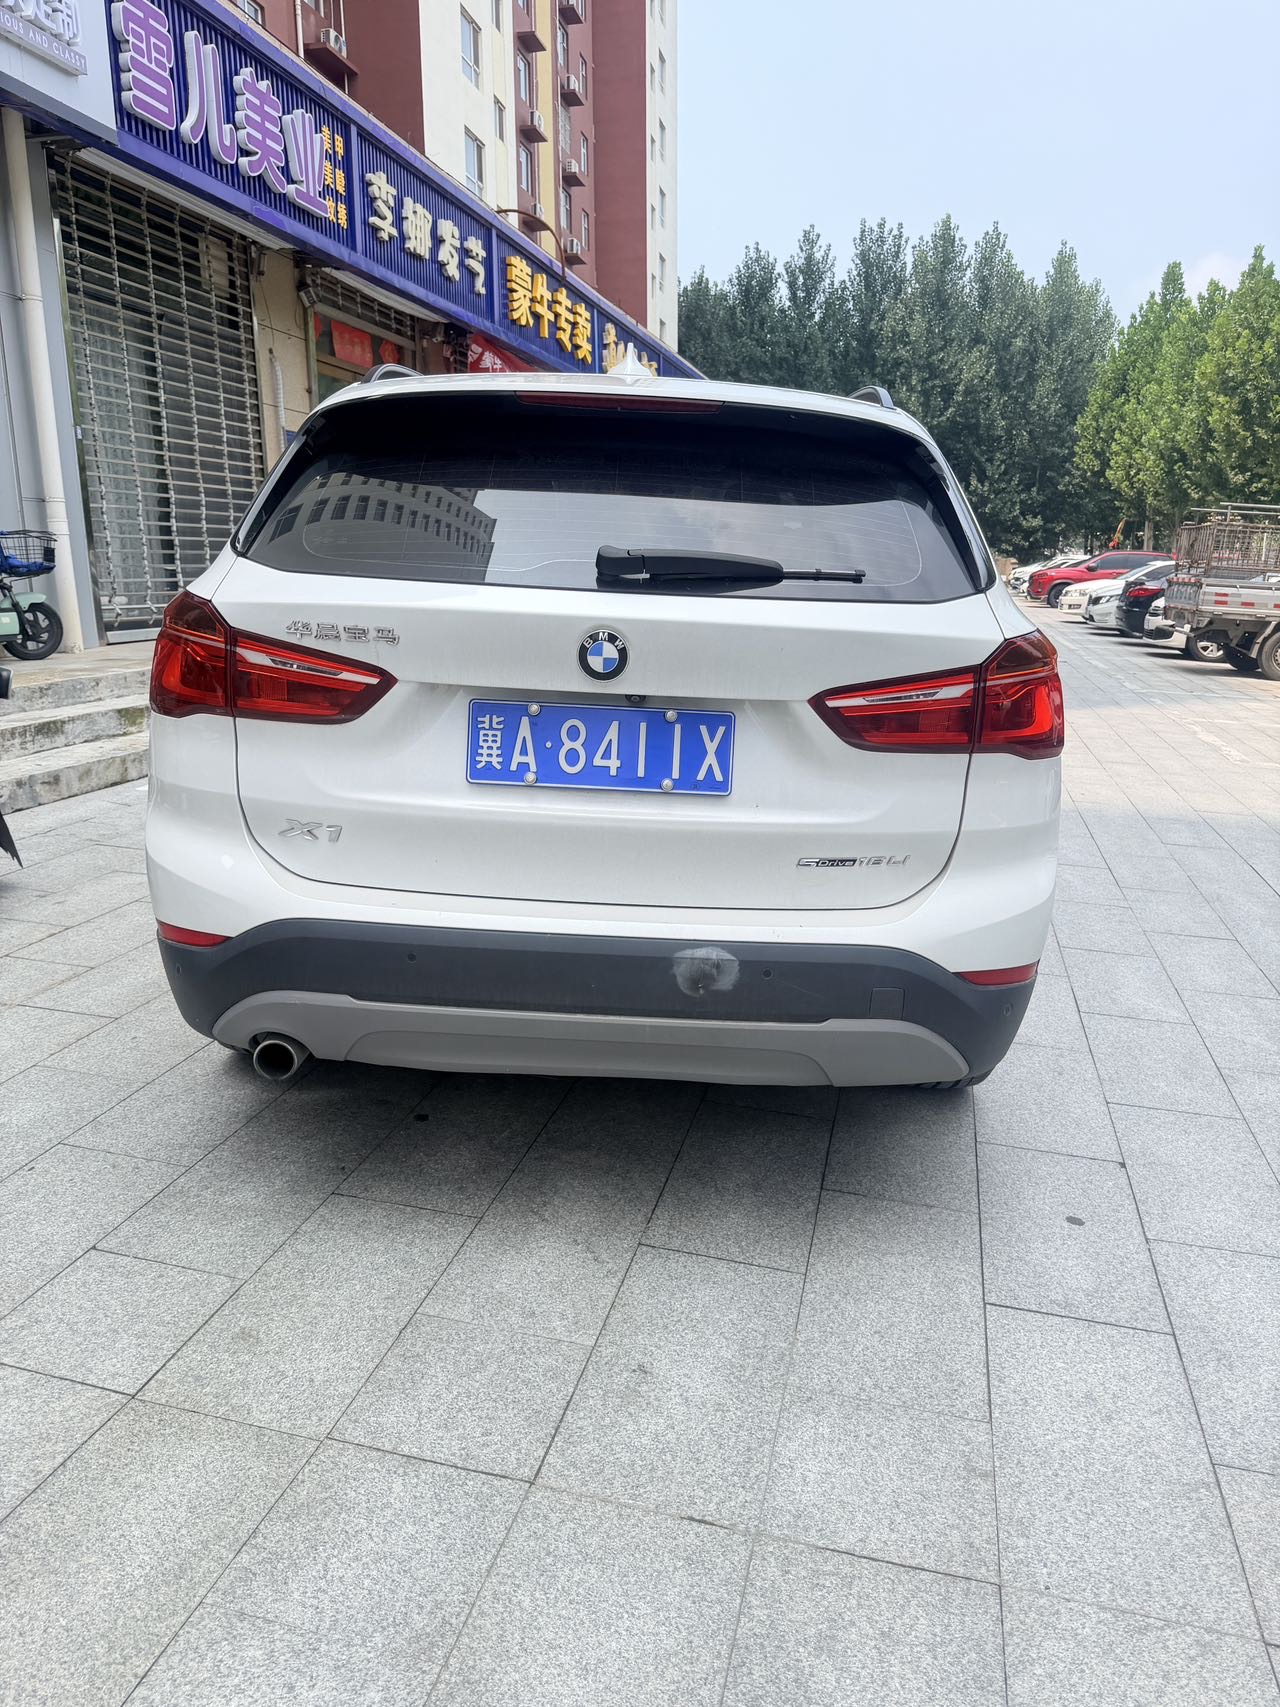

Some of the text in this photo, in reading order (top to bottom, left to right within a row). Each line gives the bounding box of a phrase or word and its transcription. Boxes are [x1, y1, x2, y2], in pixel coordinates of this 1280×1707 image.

[29, 29, 48, 48] AND
[53, 42, 86, 69] CLASSY
[111, 0, 330, 218] 雪儿美业
[365, 171, 487, 295] 李娜发艺
[506, 255, 592, 365] 蒙牛专卖
[285, 620, 400, 645] 华晨宝马
[583, 631, 625, 650] BMW
[278, 818, 343, 842] X1
